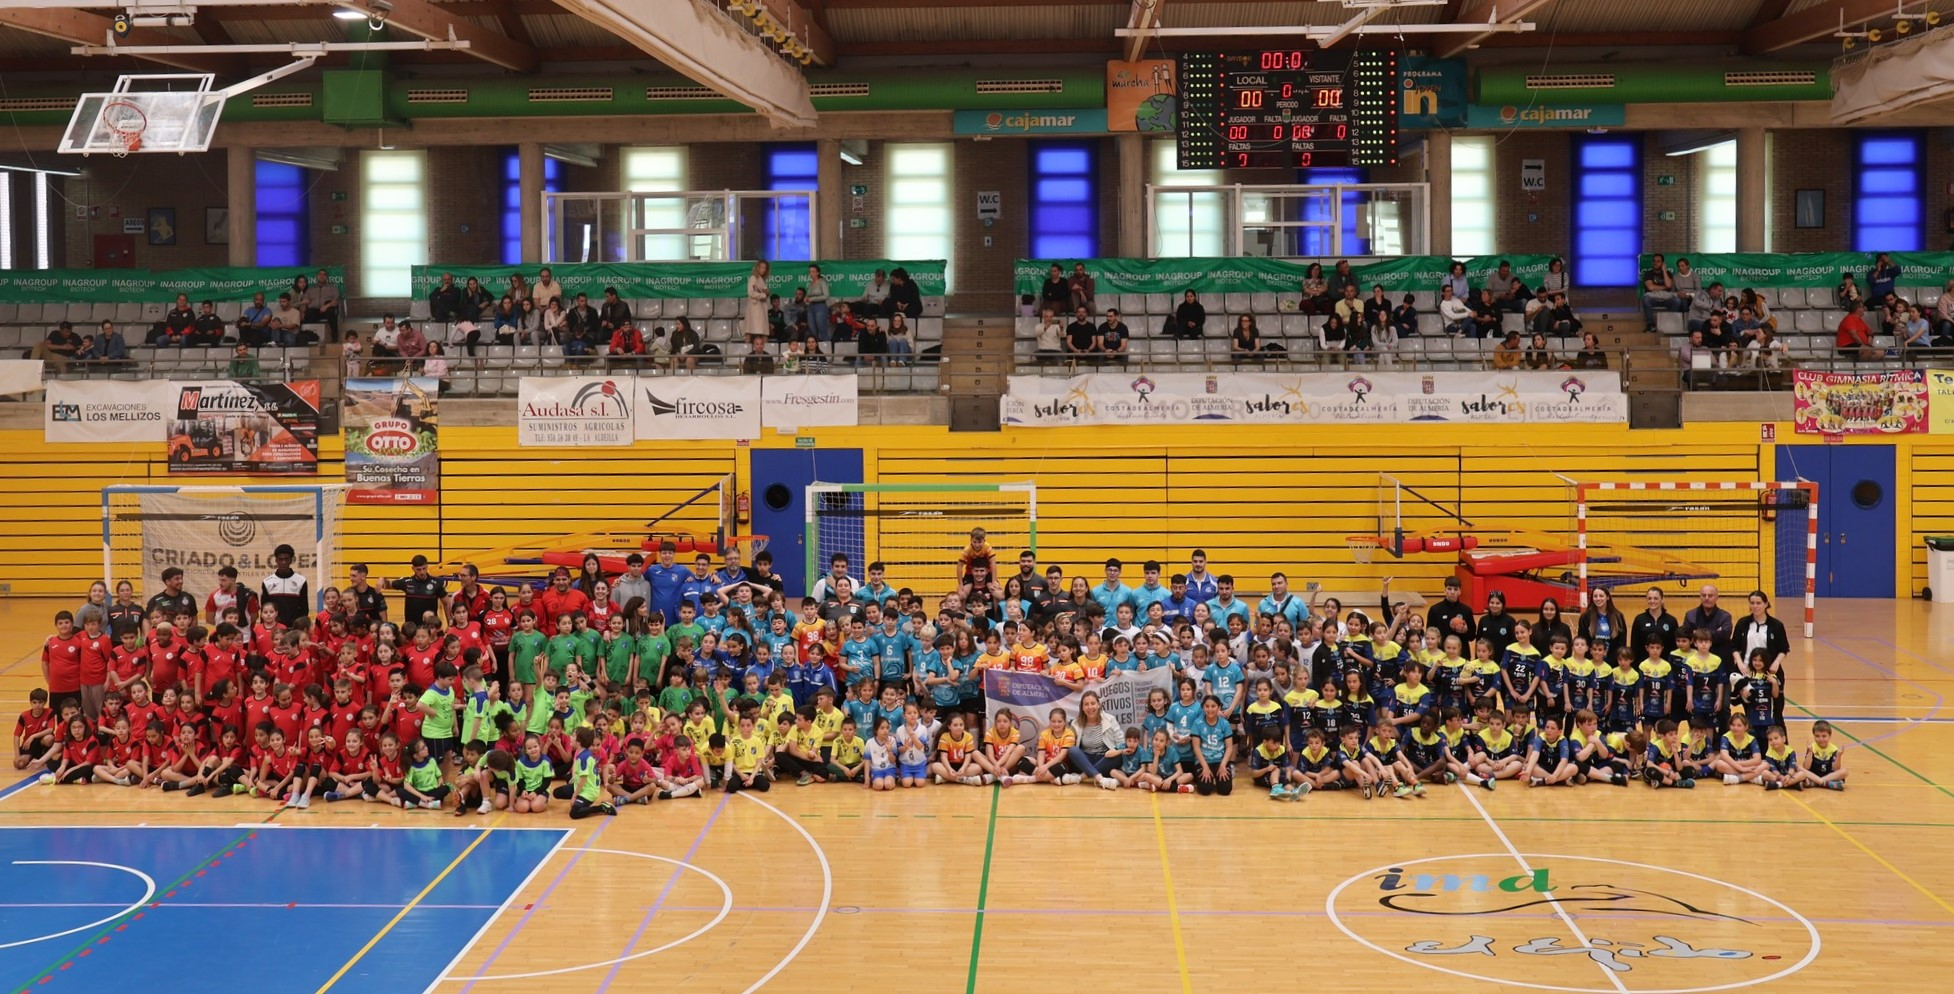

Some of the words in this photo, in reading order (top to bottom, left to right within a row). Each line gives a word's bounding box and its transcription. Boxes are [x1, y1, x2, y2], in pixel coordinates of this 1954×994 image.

[1183, 62, 1188, 70] 5
[1112, 74, 1149, 89] marcha
[1236, 76, 1268, 84] LOCAL
[1309, 75, 1340, 83] VISITANTE
[1520, 105, 1591, 124] cajamar
[1006, 112, 1075, 130] cajamar
[1104, 271, 1151, 280] INAGROUP
[1207, 270, 1253, 280] INAGROUP
[1732, 268, 1781, 276] INAGROUP
[1786, 266, 1834, 276] INAGROUP
[597, 276, 641, 285] INAGROUP
[696, 276, 742, 284] INAGROUP
[1155, 272, 1202, 280] INAGROUP
[1362, 272, 1409, 281] INAGROUP
[63, 279, 107, 287] INAGROUP
[646, 277, 691, 285] INAGROUP
[1798, 372, 1823, 382] CLUB
[1826, 375, 1877, 383] GIMNASIA
[675, 397, 735, 414] fircosa
[1034, 398, 1095, 418] sabores
[1246, 394, 1308, 414] sabores
[1462, 394, 1525, 414] sabores
[522, 402, 584, 416] Audasa
[590, 402, 609, 416] s.l.
[86, 413, 107, 421] LOS
[110, 412, 160, 421] MELLIZOS
[374, 421, 407, 429] GRUPO
[529, 423, 577, 431] SUMINISTROS
[584, 423, 625, 431] AGRICOLAS
[371, 436, 411, 450] OTTO
[357, 474, 391, 482] Buenas
[394, 474, 425, 482] Tierras
[806, 632, 818, 641] 98
[887, 646, 892, 654] 6
[1516, 664, 1525, 672] 22
[1218, 677, 1230, 687] 12
[1576, 680, 1586, 688] 30
[863, 713, 872, 722] 10
[1180, 715, 1187, 726] 4
[1207, 735, 1218, 745] 15
[953, 749, 964, 759] 14
